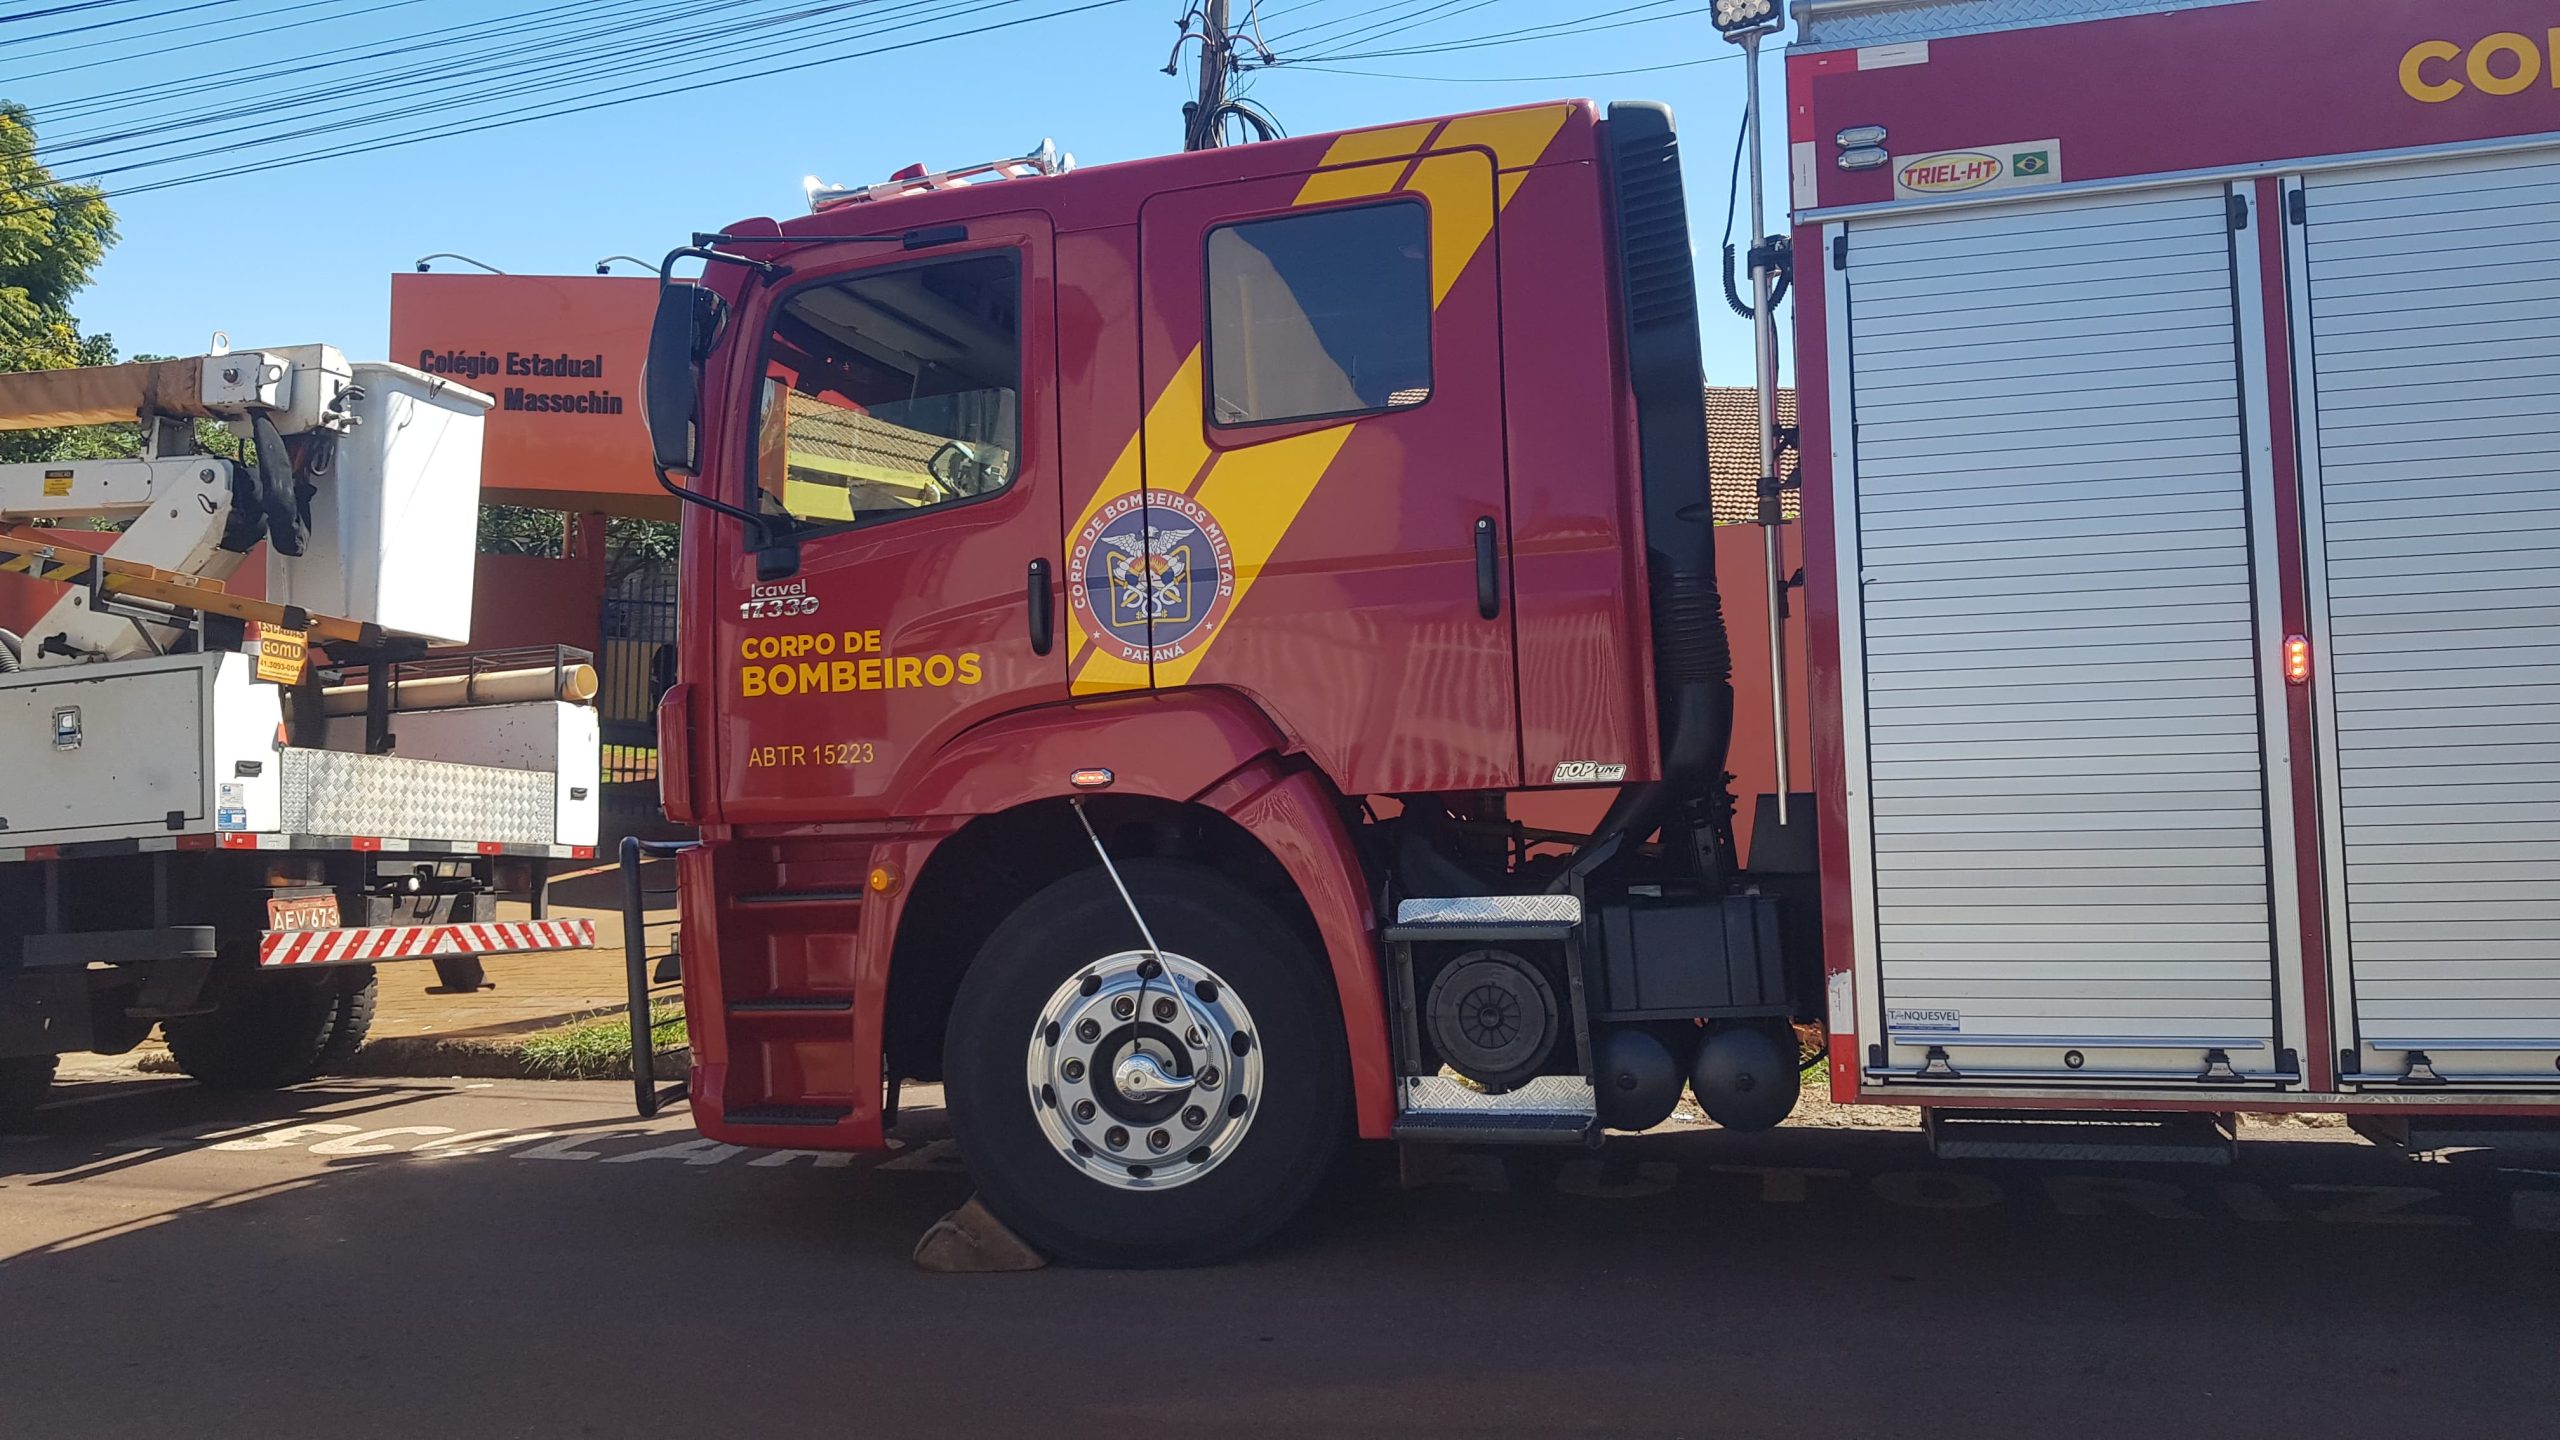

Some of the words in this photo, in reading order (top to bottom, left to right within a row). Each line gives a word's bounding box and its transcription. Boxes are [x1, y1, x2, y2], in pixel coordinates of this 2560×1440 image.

[2398, 26, 2560, 104] CO
[1904, 160, 1996, 187] TRIEL-HT
[419, 349, 499, 379] Colégio
[506, 352, 603, 378] Estadual
[504, 387, 623, 414] Massochin
[1070, 545, 1087, 609] CORPO
[1083, 517, 1105, 542] DE
[1104, 492, 1207, 523] BOMBEIROS
[1206, 523, 1233, 597] MILITAR
[262, 641, 301, 658] GOMU
[741, 632, 836, 660] CORPO
[844, 629, 882, 654] DE
[1122, 642, 1185, 662] PARANÁ
[742, 652, 983, 697] BOMBEIROS
[749, 745, 806, 767] ABTR
[813, 743, 875, 765] 15223
